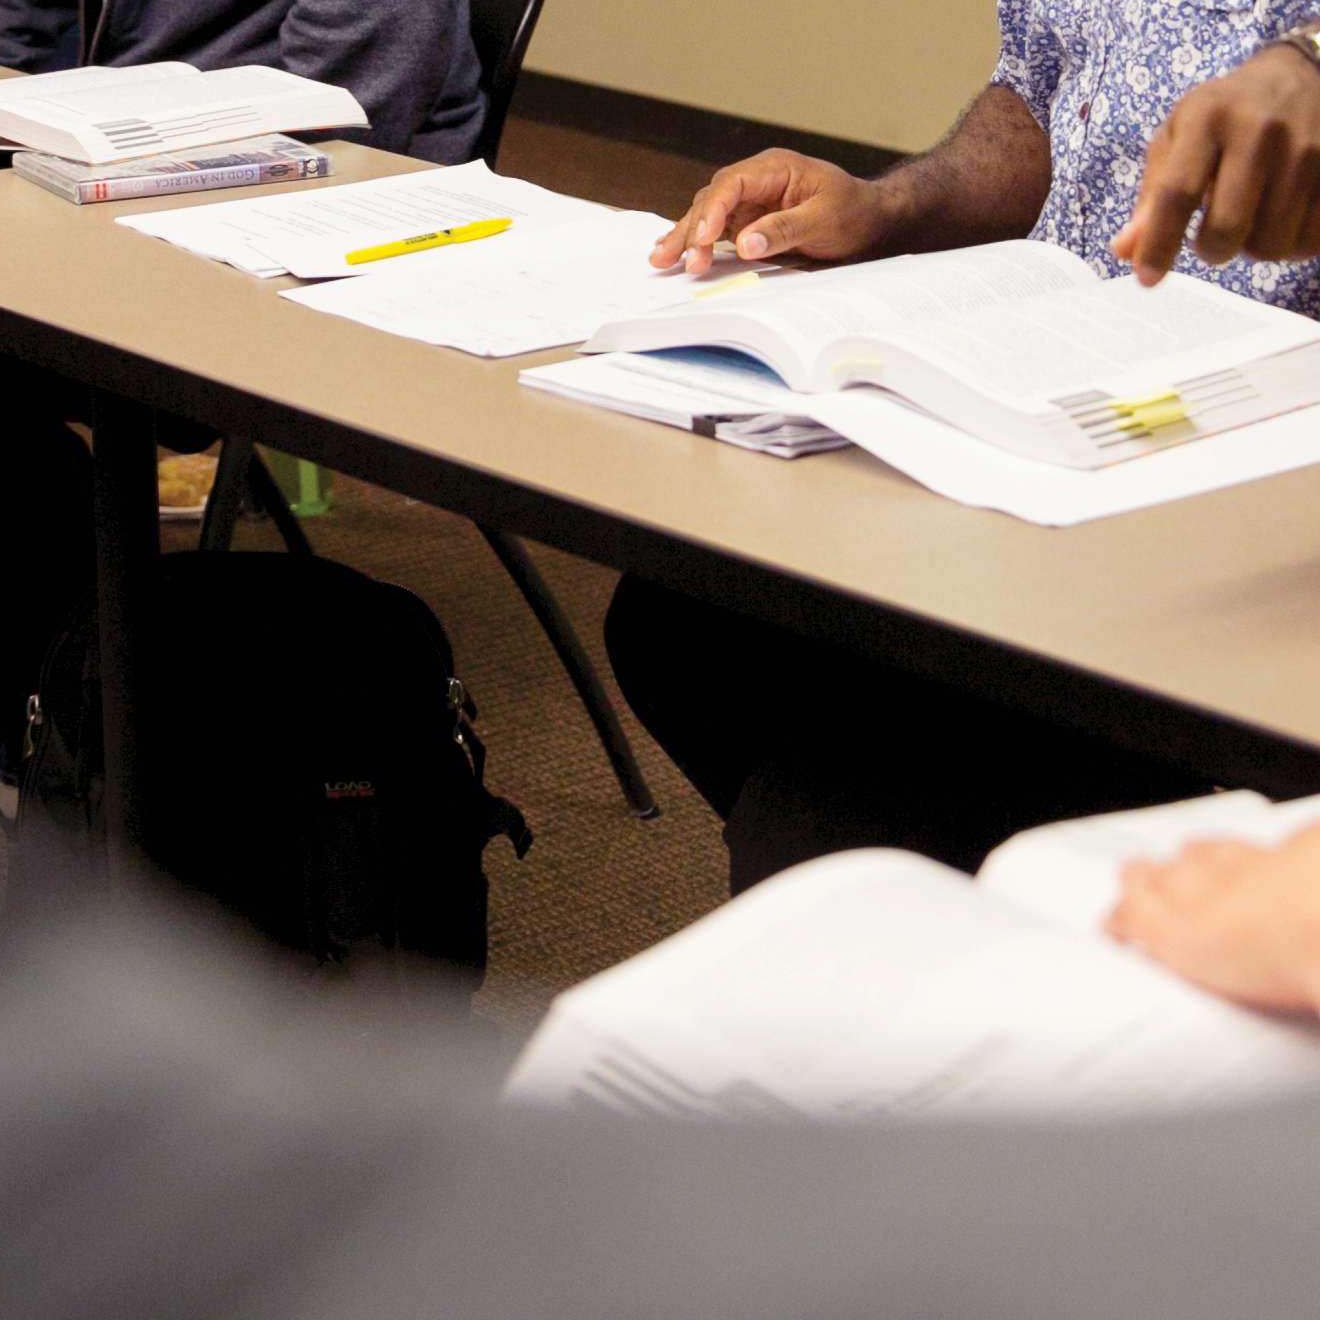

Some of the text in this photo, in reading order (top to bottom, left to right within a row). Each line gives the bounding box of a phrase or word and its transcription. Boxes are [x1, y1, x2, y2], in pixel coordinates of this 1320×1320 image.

[155, 169, 255, 188] GOD IN AMERICA
